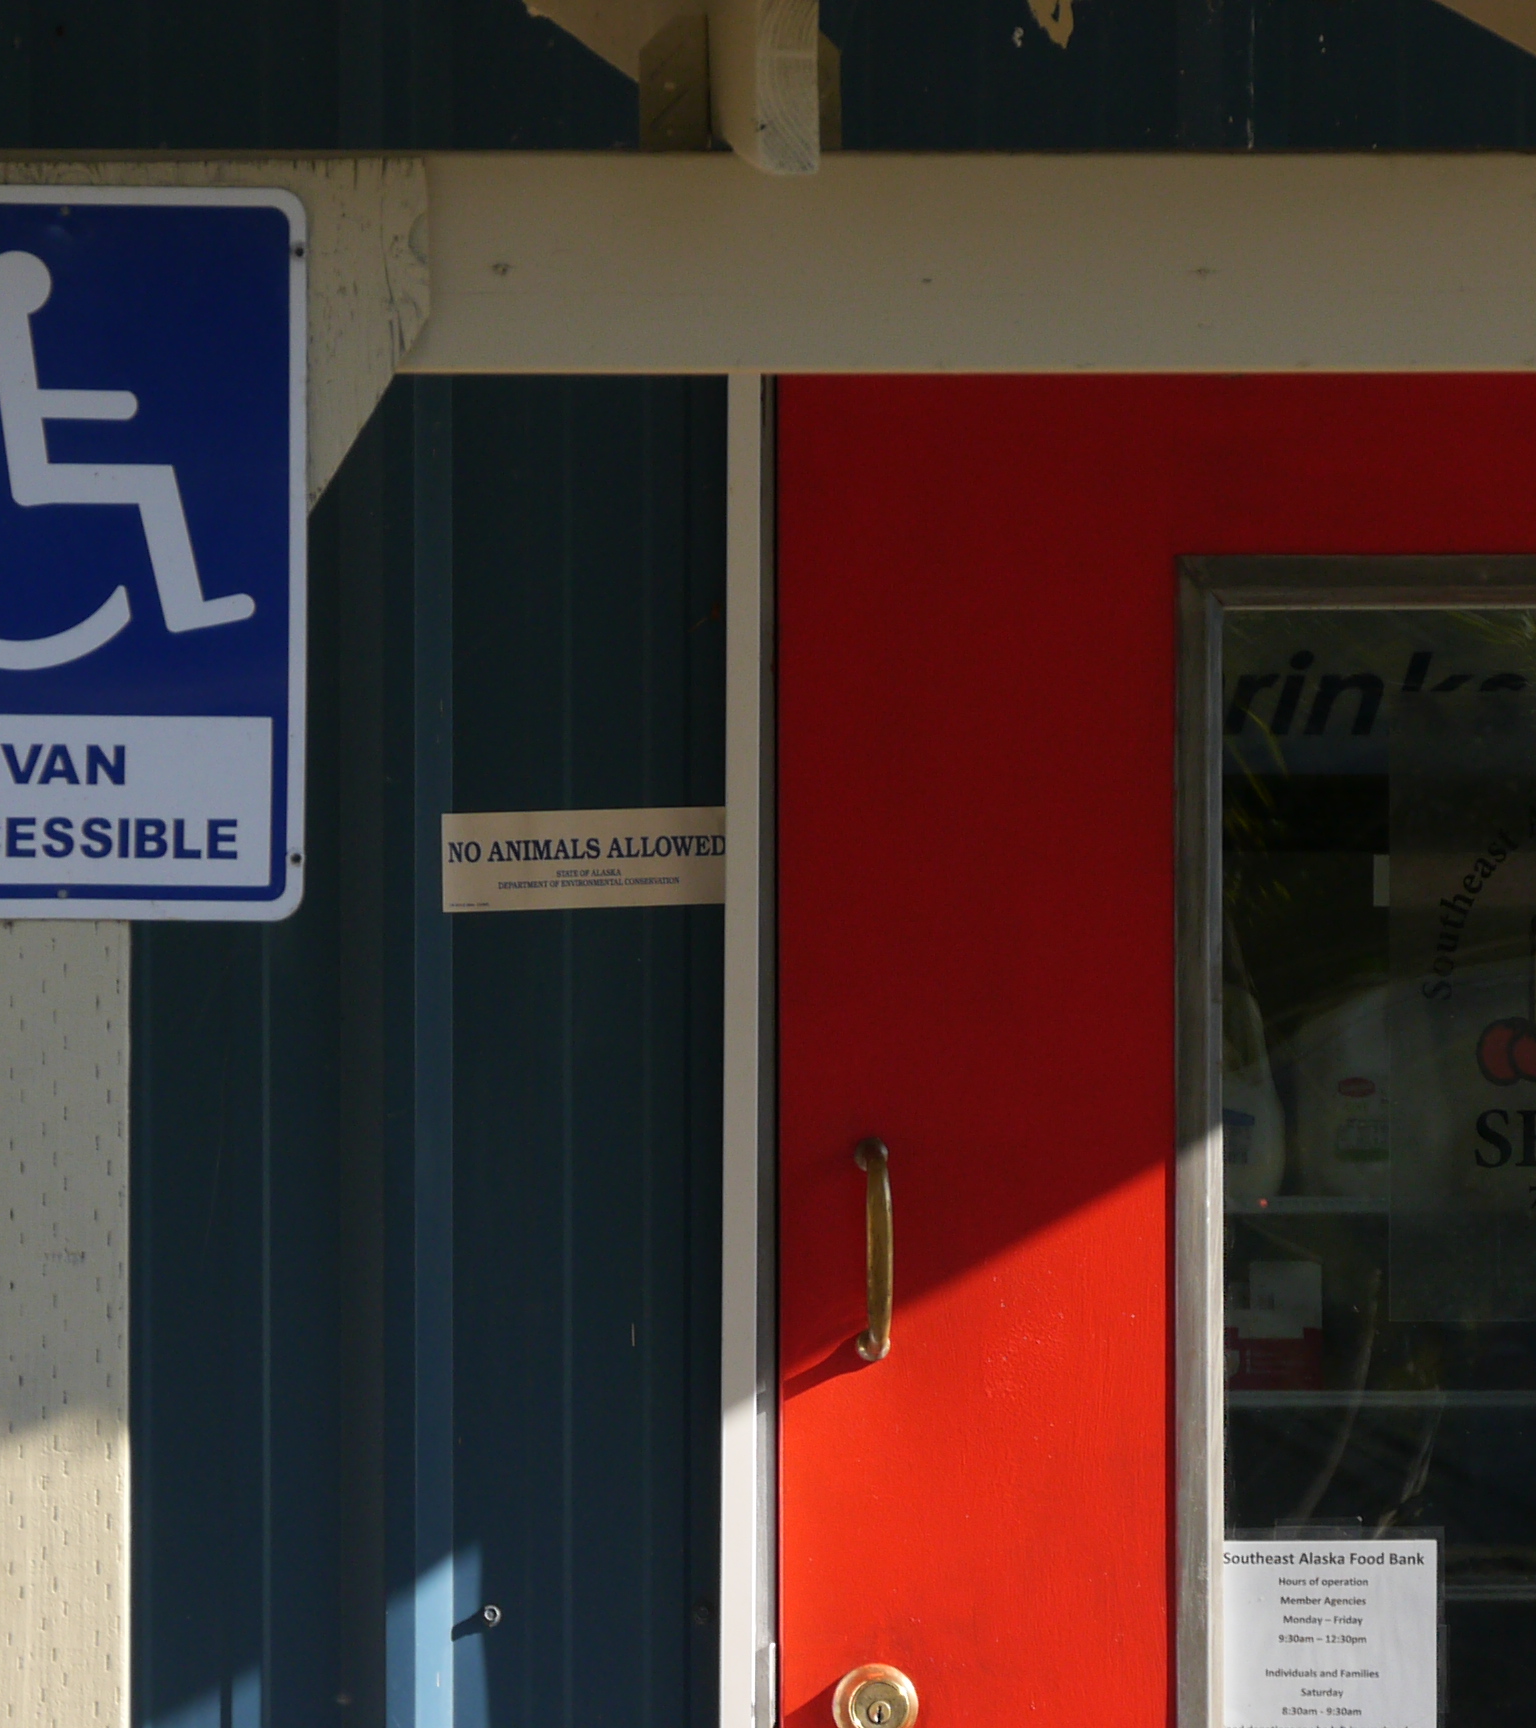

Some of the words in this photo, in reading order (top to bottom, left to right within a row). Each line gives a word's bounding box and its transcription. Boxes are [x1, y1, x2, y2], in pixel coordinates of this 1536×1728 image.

[1222, 650, 1527, 736] rin
[0, 743, 126, 785] VAN
[447, 840, 481, 863] NO
[487, 837, 601, 862] ANIMALS
[606, 834, 726, 859] ALLOWED
[556, 869, 578, 878] STATE
[579, 869, 589, 877] OF
[590, 868, 622, 877] ALASKA
[498, 879, 548, 890] DEPARTMENT
[549, 879, 559, 887] OF
[560, 877, 624, 888] ENVIRONMENTAL
[1422, 826, 1519, 1001] Southeast
[1223, 1550, 1296, 1566] Southeast
[1297, 1551, 1346, 1566] Alaska
[1348, 1551, 1386, 1566] Food
[1388, 1551, 1425, 1566] Bank
[1278, 1576, 1308, 1587] Hours
[1308, 1576, 1320, 1587] of
[1320, 1576, 1369, 1589] operation
[1279, 1595, 1322, 1606] Member
[1323, 1595, 1367, 1608] Agencies
[1282, 1614, 1324, 1627] Monday
[1333, 1615, 1364, 1628] Friday
[1277, 1633, 1315, 1644] 9:30am
[1325, 1633, 1368, 1646] 12:30pm
[1264, 1667, 1318, 1679] Individuals
[1319, 1668, 1339, 1679] and
[1339, 1668, 1380, 1679] Families
[1300, 1687, 1344, 1700] Saturday
[1281, 1706, 1318, 1716] 8:30am
[1325, 1706, 1363, 1717] 9:30am
